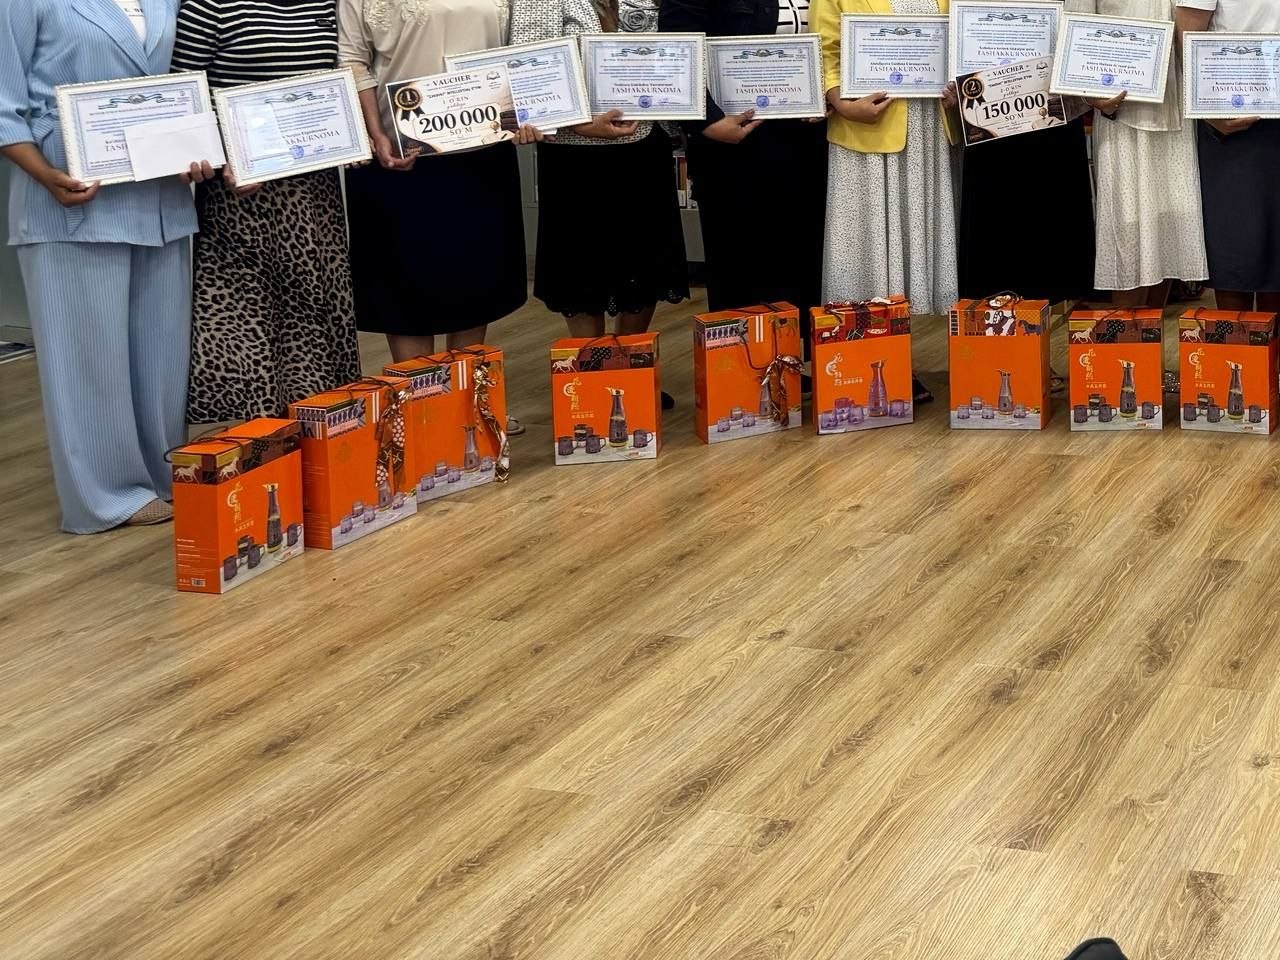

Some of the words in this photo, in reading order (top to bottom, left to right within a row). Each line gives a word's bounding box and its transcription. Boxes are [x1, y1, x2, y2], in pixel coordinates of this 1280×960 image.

[993, 64, 1024, 76] VAUCHER
[969, 80, 976, 91] 2
[983, 100, 1010, 120] 150
[1014, 93, 1045, 112] 000
[419, 112, 457, 134] 200
[459, 105, 497, 126] 000
